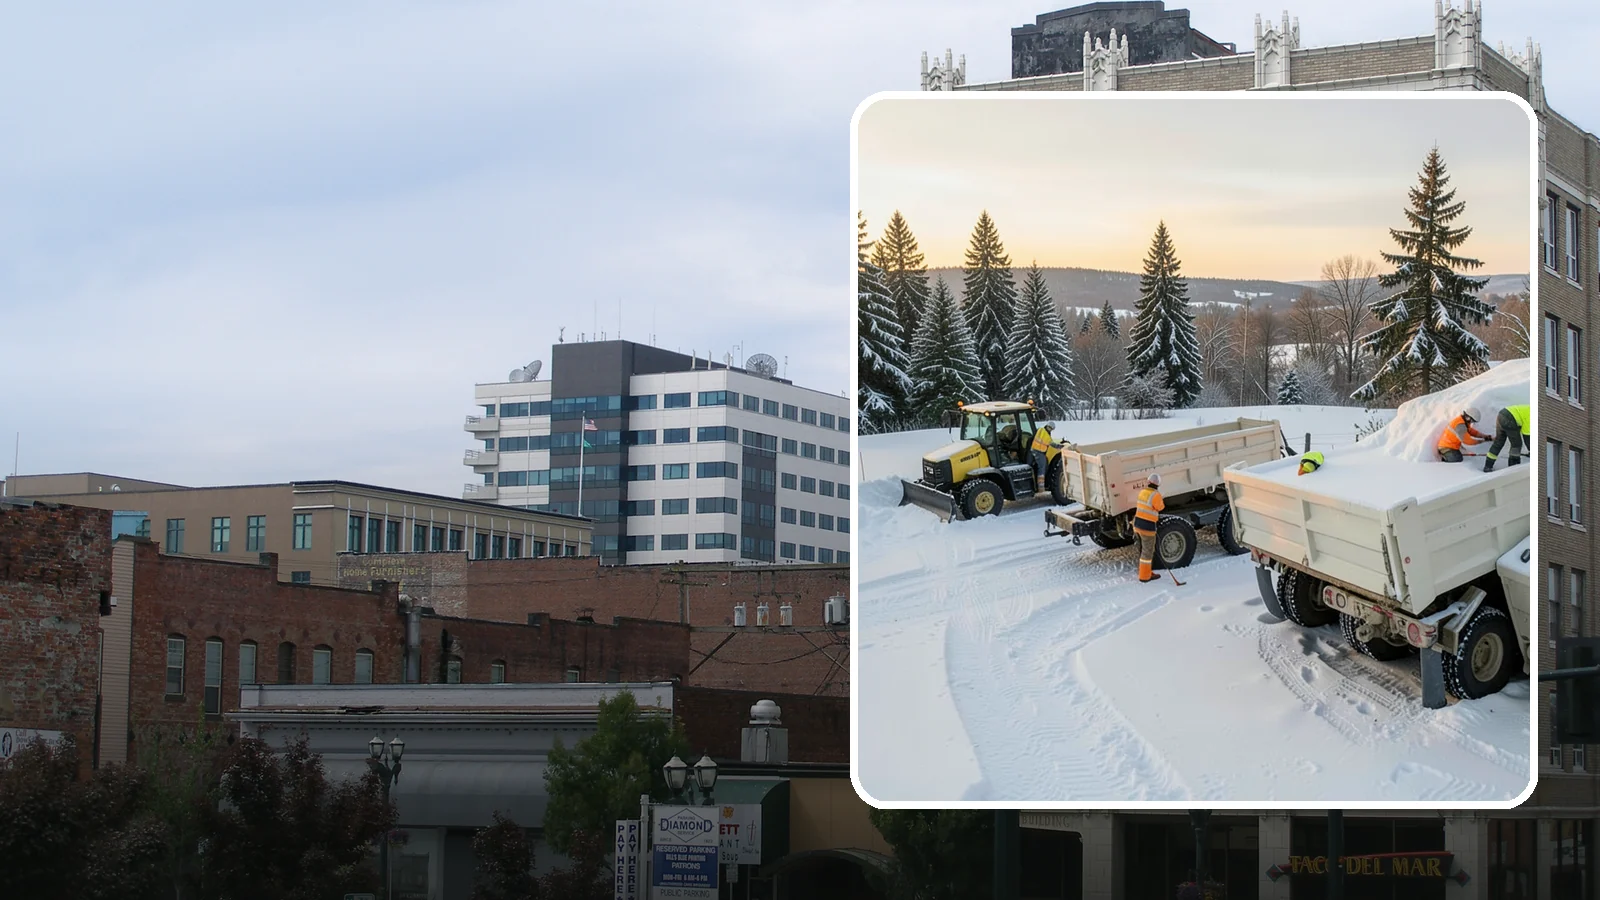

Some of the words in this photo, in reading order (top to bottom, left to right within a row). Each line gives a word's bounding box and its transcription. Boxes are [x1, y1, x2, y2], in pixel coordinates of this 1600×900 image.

[370, 566, 427, 577] Furnishers
[660, 818, 713, 833] DIAMOND
[1022, 815, 1070, 828] BUILDING
[617, 825, 625, 852] PAY
[628, 824, 636, 852] PAY
[656, 845, 688, 853] RESERVED
[689, 846, 716, 854] PARKING
[721, 851, 739, 862] Soup
[671, 862, 701, 870] PATRONS
[1289, 855, 1329, 874] TAC
[1346, 856, 1385, 876] DEL
[1391, 856, 1442, 877] MAR
[616, 856, 625, 893] HERE
[627, 856, 636, 893] HERE
[660, 888, 682, 897] PUBLIC
[684, 889, 710, 898] PARKING
